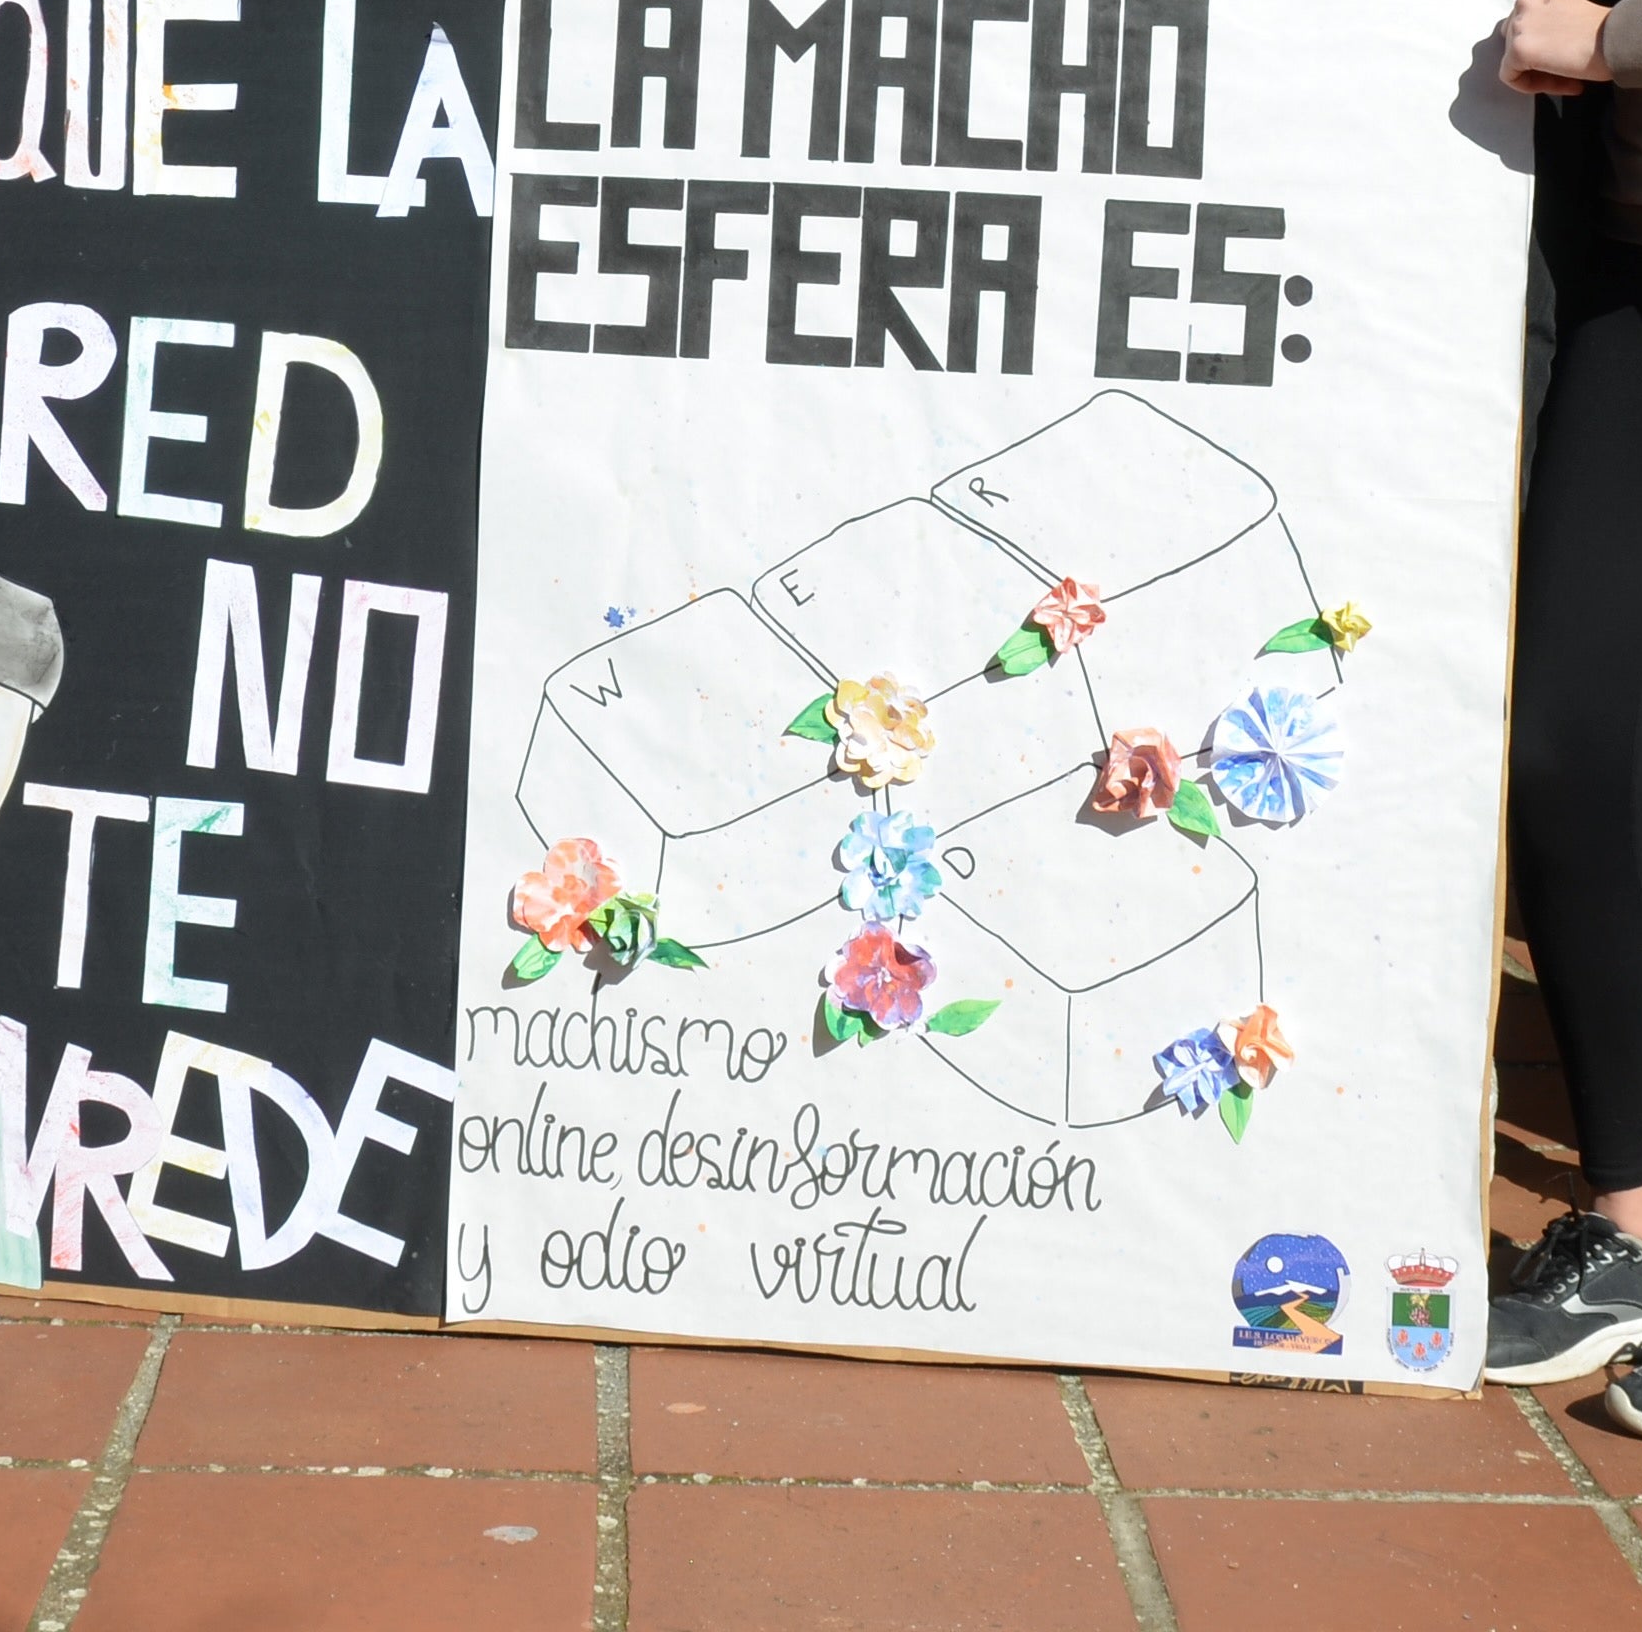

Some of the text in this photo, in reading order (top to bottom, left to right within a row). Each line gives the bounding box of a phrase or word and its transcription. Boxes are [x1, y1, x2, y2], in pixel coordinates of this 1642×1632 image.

[505, 172, 1314, 387] ESFERA ES:
[967, 475, 1009, 509] R
[778, 569, 817, 609] E
[185, 558, 449, 794] NO
[569, 658, 625, 708] W
[23, 782, 245, 1014] TE
[465, 1004, 788, 1083] machismo
[638, 1088, 1102, 1210] desinformación
[458, 1196, 987, 1313] y odio virtual
